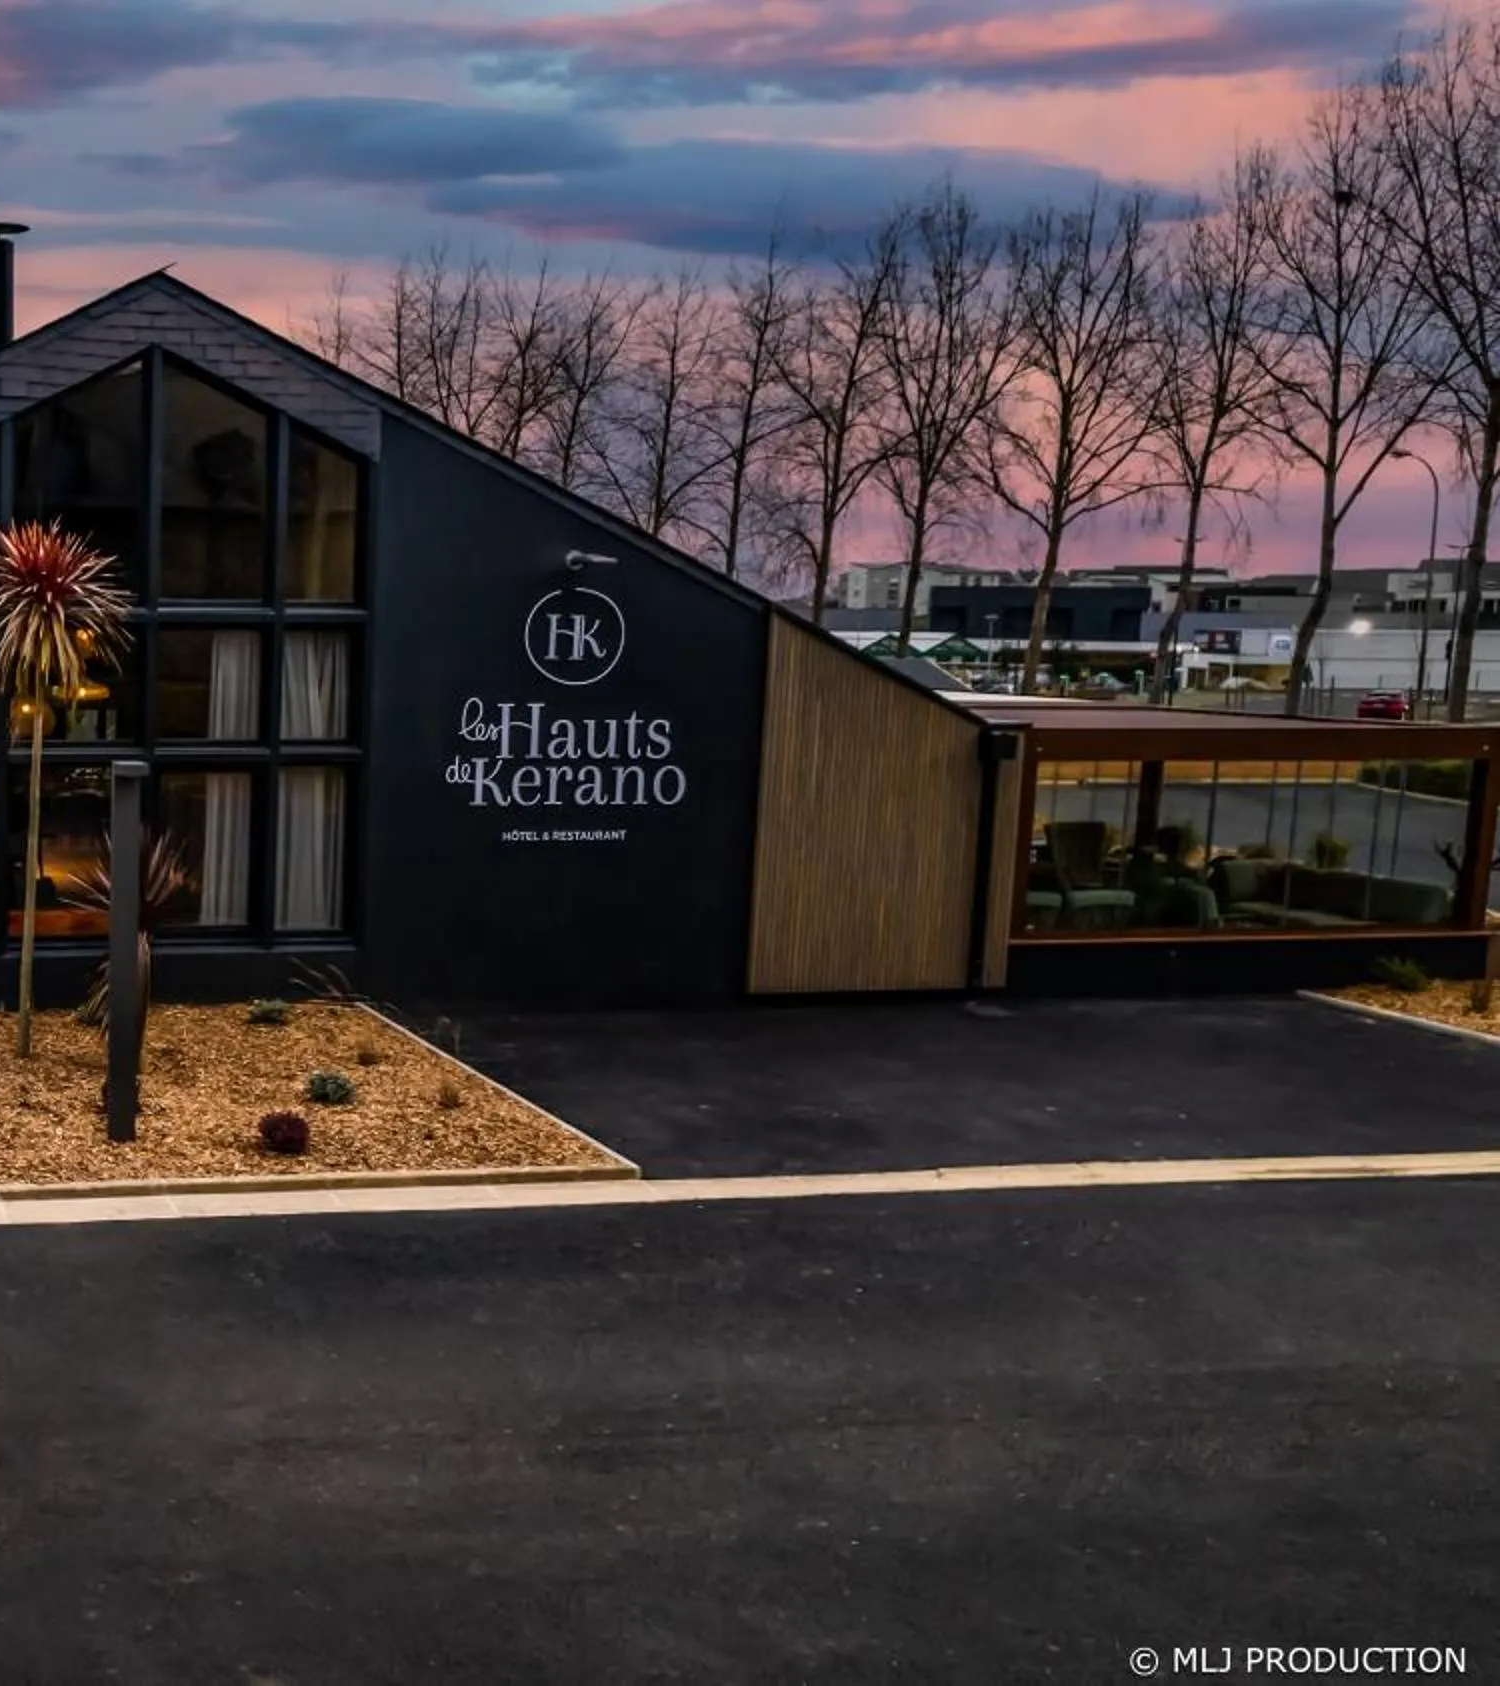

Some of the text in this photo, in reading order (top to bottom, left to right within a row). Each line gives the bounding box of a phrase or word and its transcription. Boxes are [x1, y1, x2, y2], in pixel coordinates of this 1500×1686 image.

[544, 613, 607, 661] HK
[496, 703, 672, 759] Hauts
[445, 755, 687, 807] de Kerano
[552, 829, 627, 841] RESTAURANT
